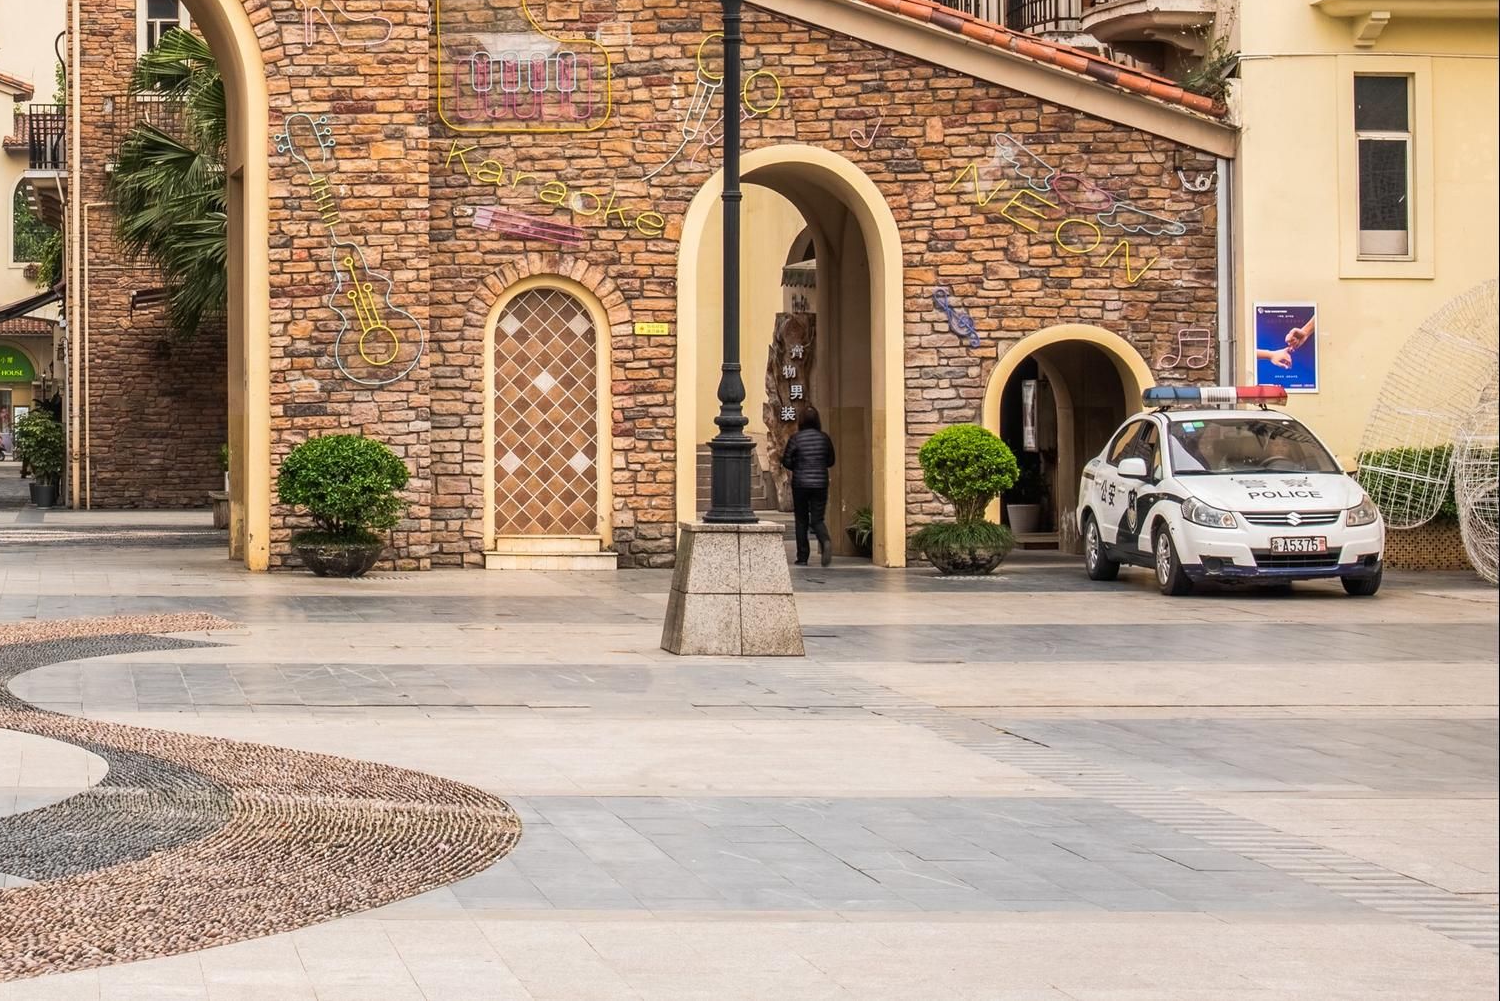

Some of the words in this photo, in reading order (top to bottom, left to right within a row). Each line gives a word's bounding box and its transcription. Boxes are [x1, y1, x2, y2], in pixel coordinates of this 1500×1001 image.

[445, 139, 665, 236] Karaoke
[948, 162, 1159, 283] NEON
[1101, 480, 1116, 507] 公安
[1247, 491, 1323, 500] POLICE
